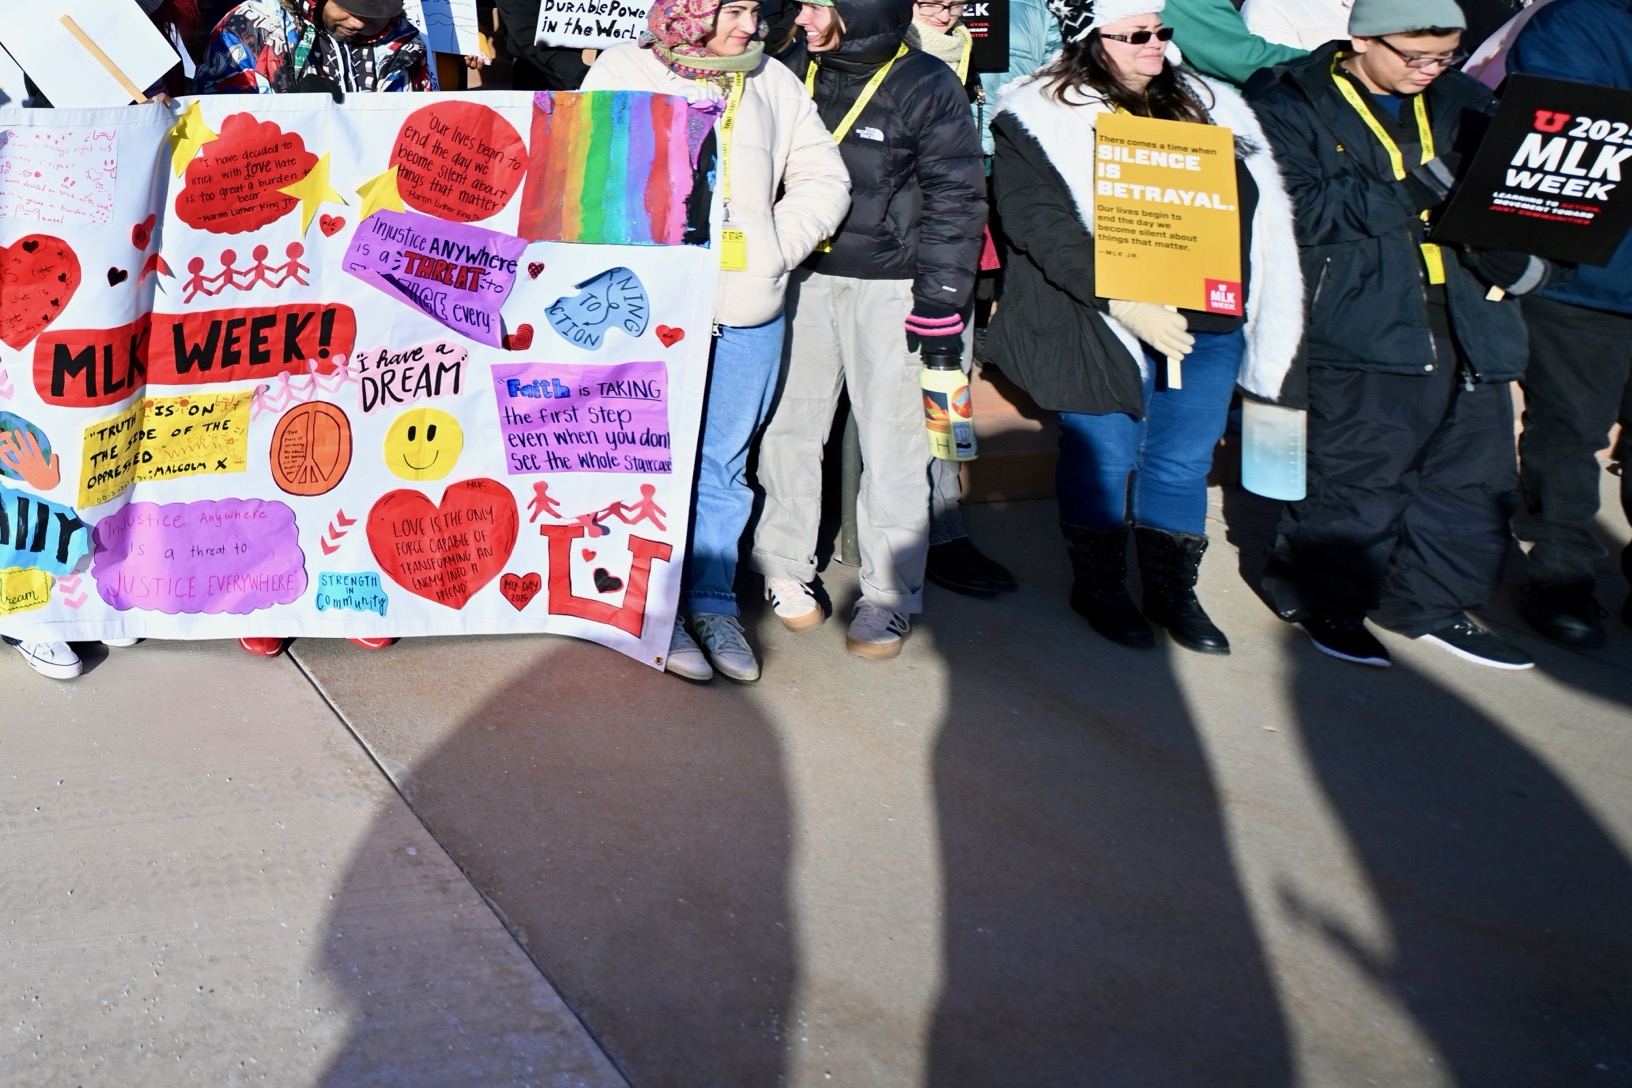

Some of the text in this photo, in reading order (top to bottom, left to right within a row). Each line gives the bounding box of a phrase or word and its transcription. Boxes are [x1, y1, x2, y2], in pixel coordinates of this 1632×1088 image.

[564, 17, 593, 36] the
[1099, 134, 1125, 145] There
[1126, 139, 1157, 149] comes
[1167, 143, 1189, 153] time
[1190, 145, 1217, 155] when
[1098, 144, 1201, 171] SILENCE
[1510, 132, 1632, 182] MLK
[1098, 163, 1121, 179] IS
[1505, 168, 1616, 201] WEEK
[1097, 181, 1235, 211] BETRAYAL.
[1097, 204, 1182, 221] Our lives begin to
[1097, 214, 1171, 229] end the day we
[1097, 224, 1197, 242] become silent about
[1098, 234, 1191, 252] things that matter.
[50, 307, 338, 398] MLK WEEK!
[371, 342, 456, 370] have a
[579, 380, 661, 398] is TAKING
[155, 403, 215, 416] IS ON
[502, 406, 580, 425] the first
[171, 419, 231, 438] OF THE
[508, 429, 636, 451] even when you
[321, 574, 378, 587] STRENGTH
